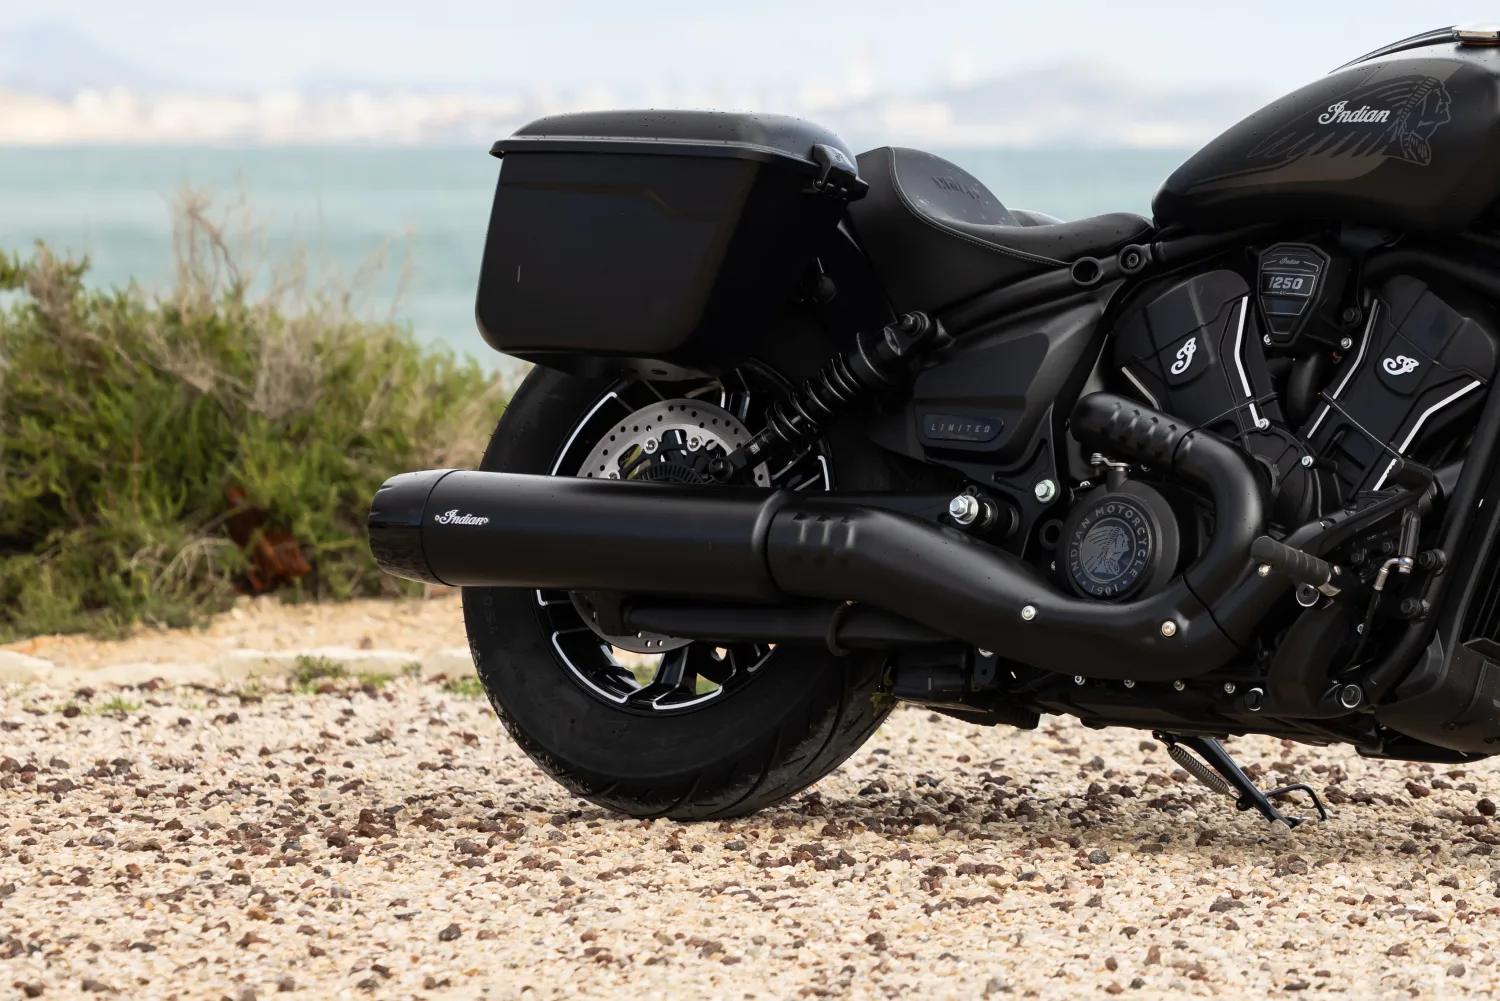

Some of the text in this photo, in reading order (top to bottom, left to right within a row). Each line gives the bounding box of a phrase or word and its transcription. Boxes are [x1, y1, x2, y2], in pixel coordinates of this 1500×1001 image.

[1318, 100, 1391, 125] Indian
[1268, 276, 1304, 290] 1250
[931, 423, 991, 433] LIMITED
[438, 509, 485, 526] Indian
[1070, 504, 1147, 578] INDIAN MOTORCYCLE
